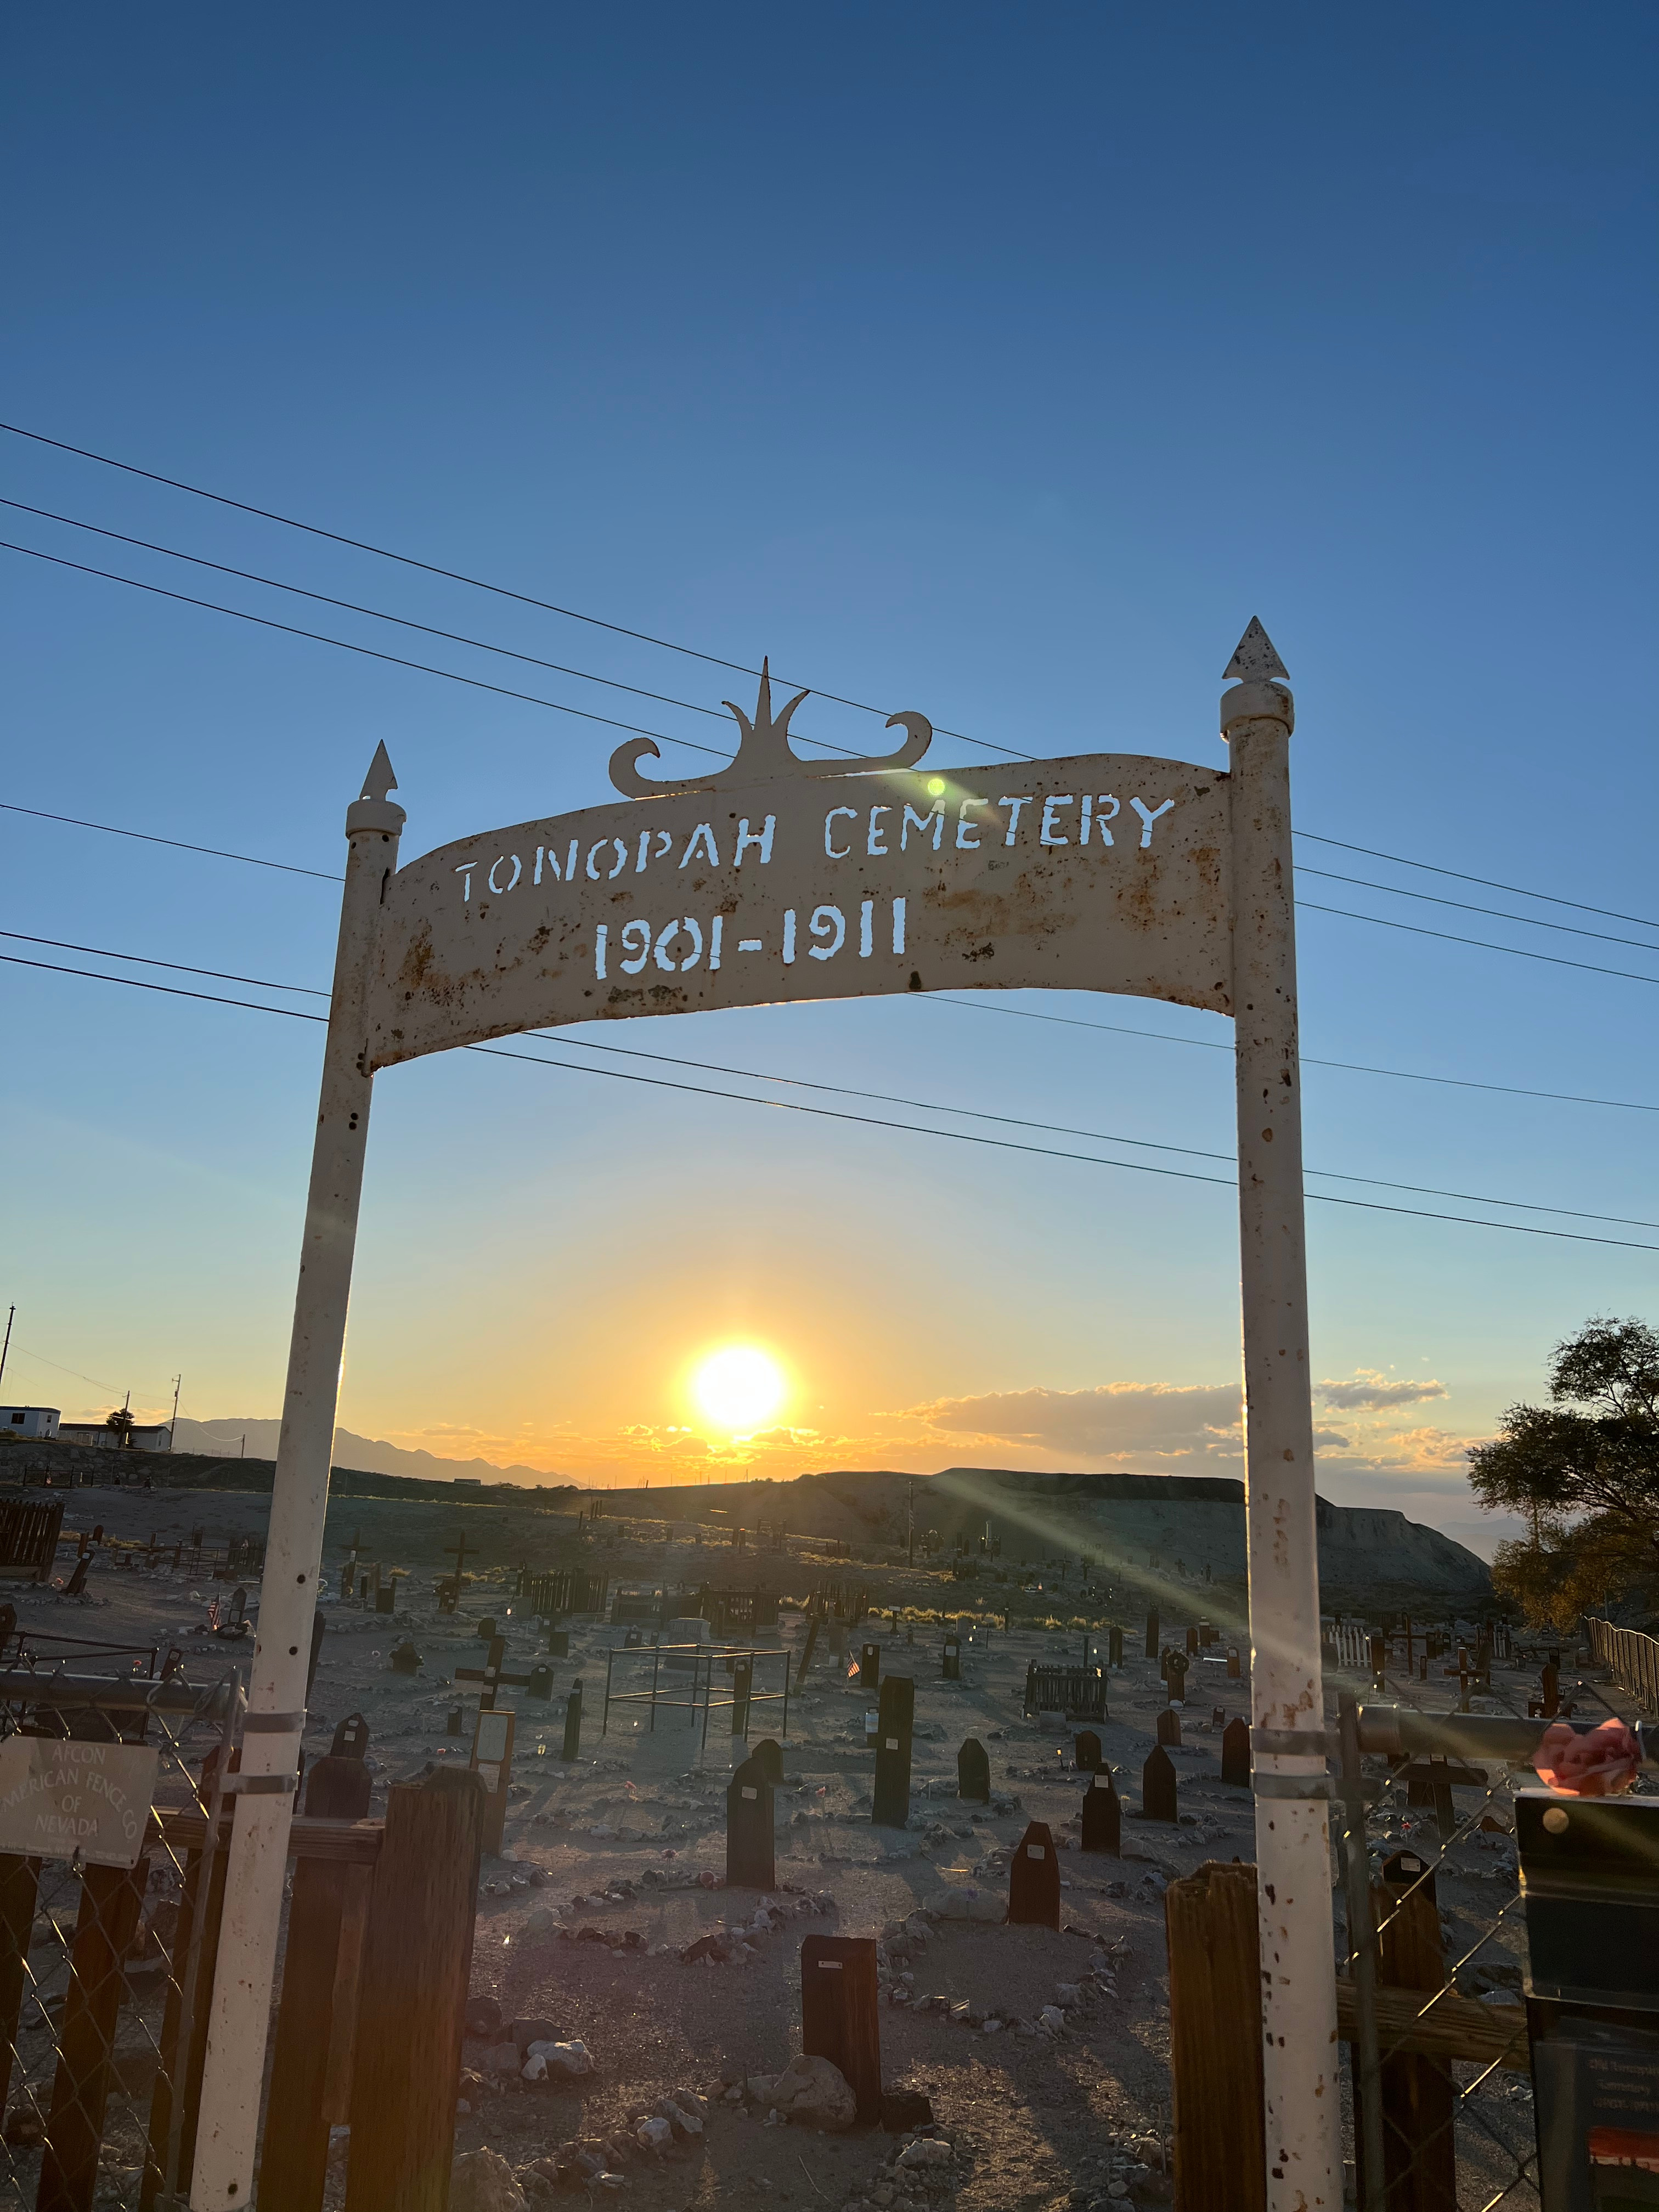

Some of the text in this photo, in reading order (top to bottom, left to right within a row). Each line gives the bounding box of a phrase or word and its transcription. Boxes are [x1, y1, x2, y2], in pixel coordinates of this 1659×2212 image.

[455, 793, 1175, 902] TONOPAH CEMETERY
[594, 897, 906, 979] 1901-1911
[34, 1814, 98, 1837] NEVADA
[61, 1795, 82, 1813] OF
